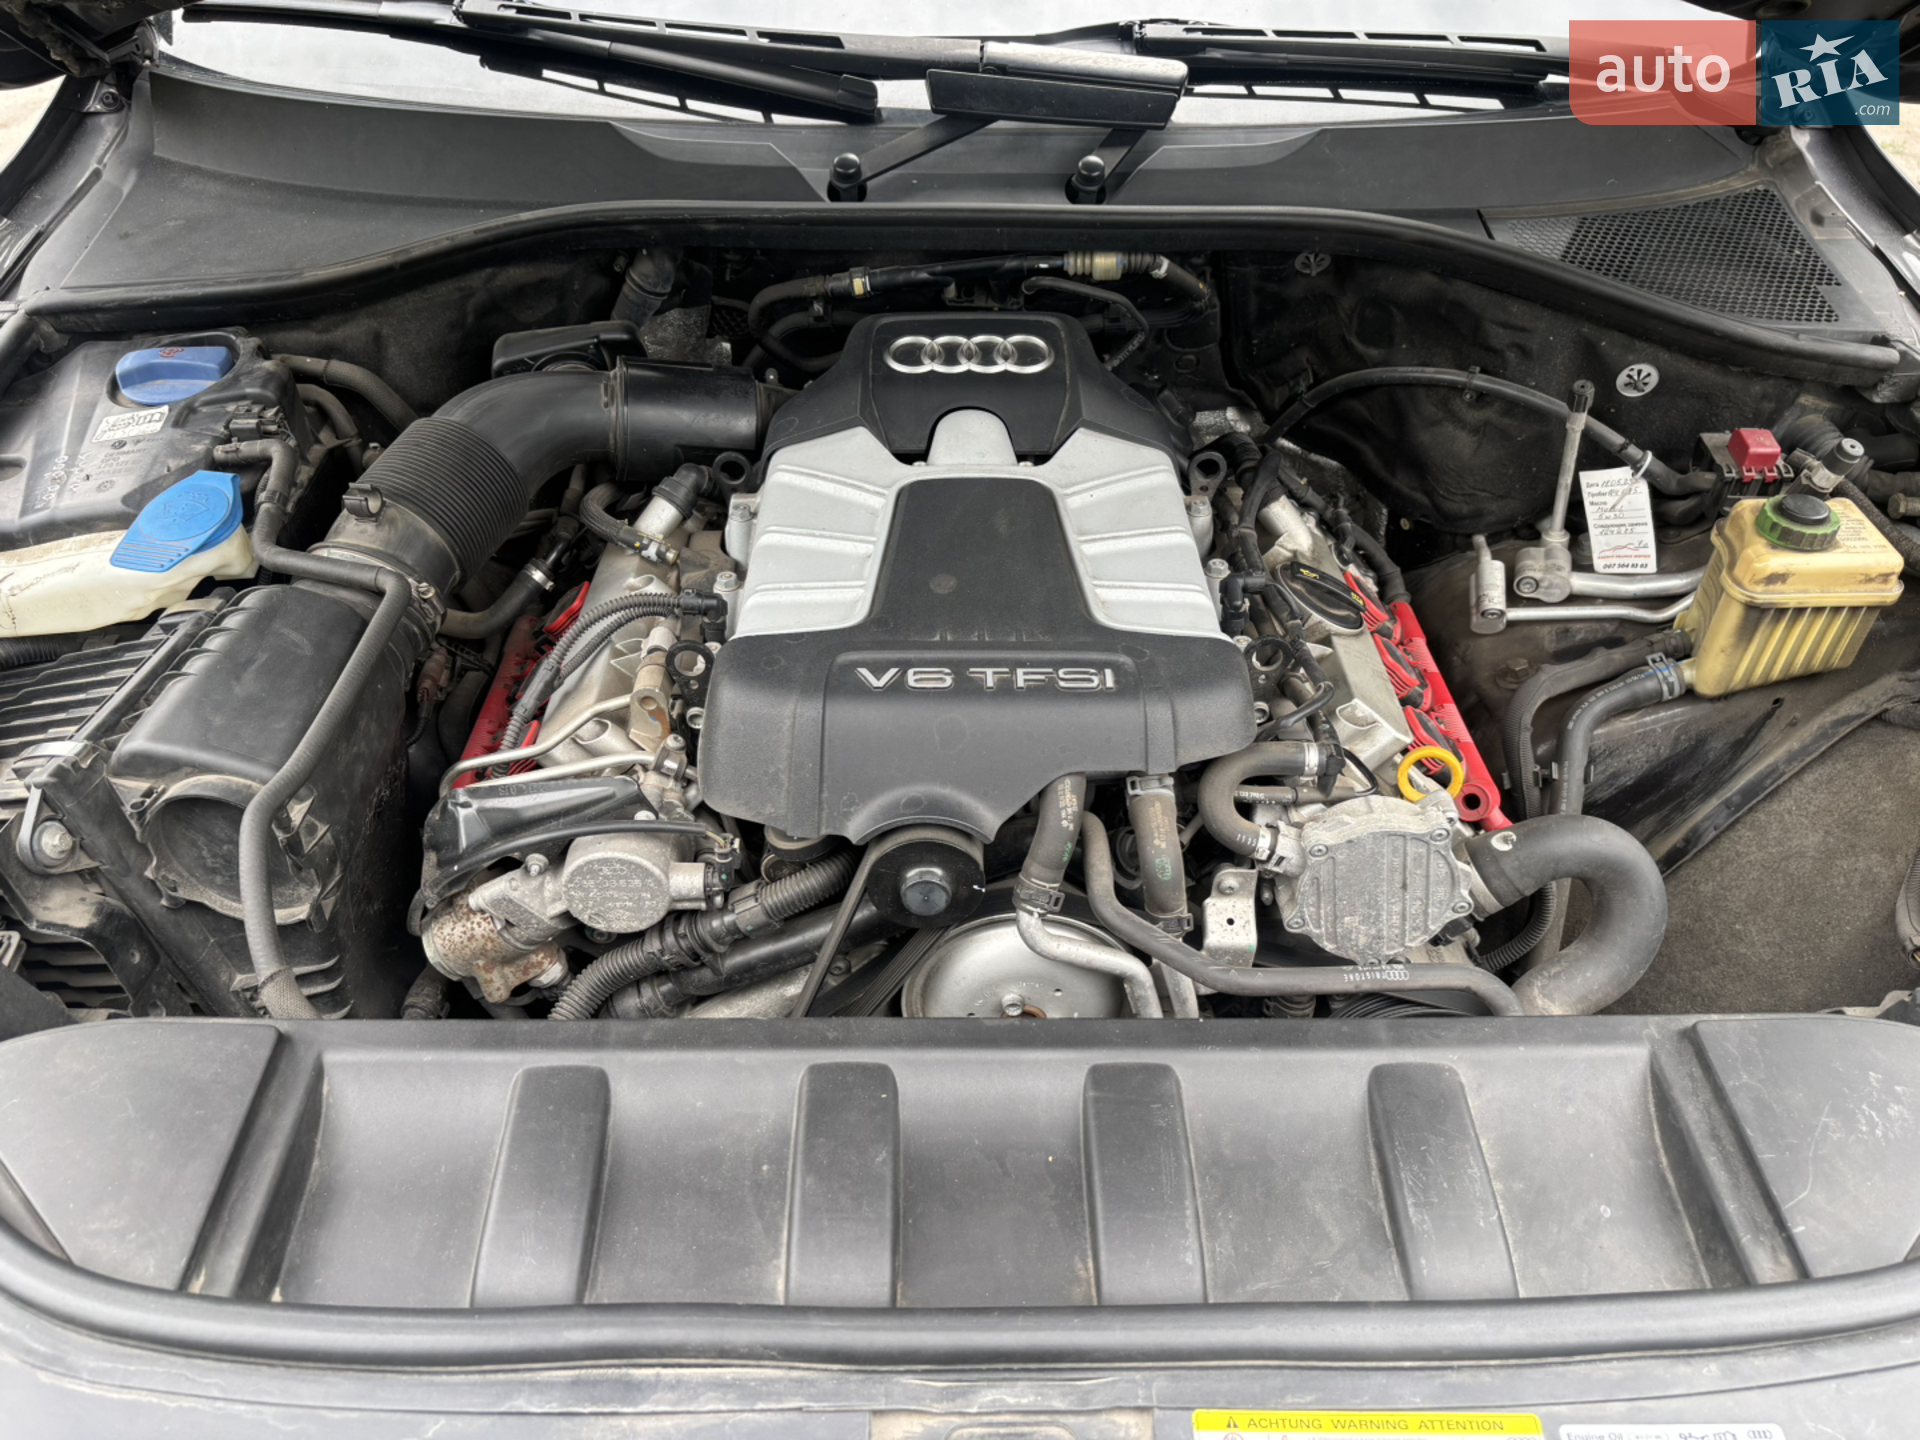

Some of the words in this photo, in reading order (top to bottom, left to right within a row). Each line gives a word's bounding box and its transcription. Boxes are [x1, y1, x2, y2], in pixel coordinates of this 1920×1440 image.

[855, 667, 954, 691] V6
[966, 667, 1116, 692] TFSI
[1247, 1418, 1323, 1430] ACHTUNG
[1331, 1419, 1409, 1431] WARNING
[1418, 1420, 1505, 1432] ATTENTION
